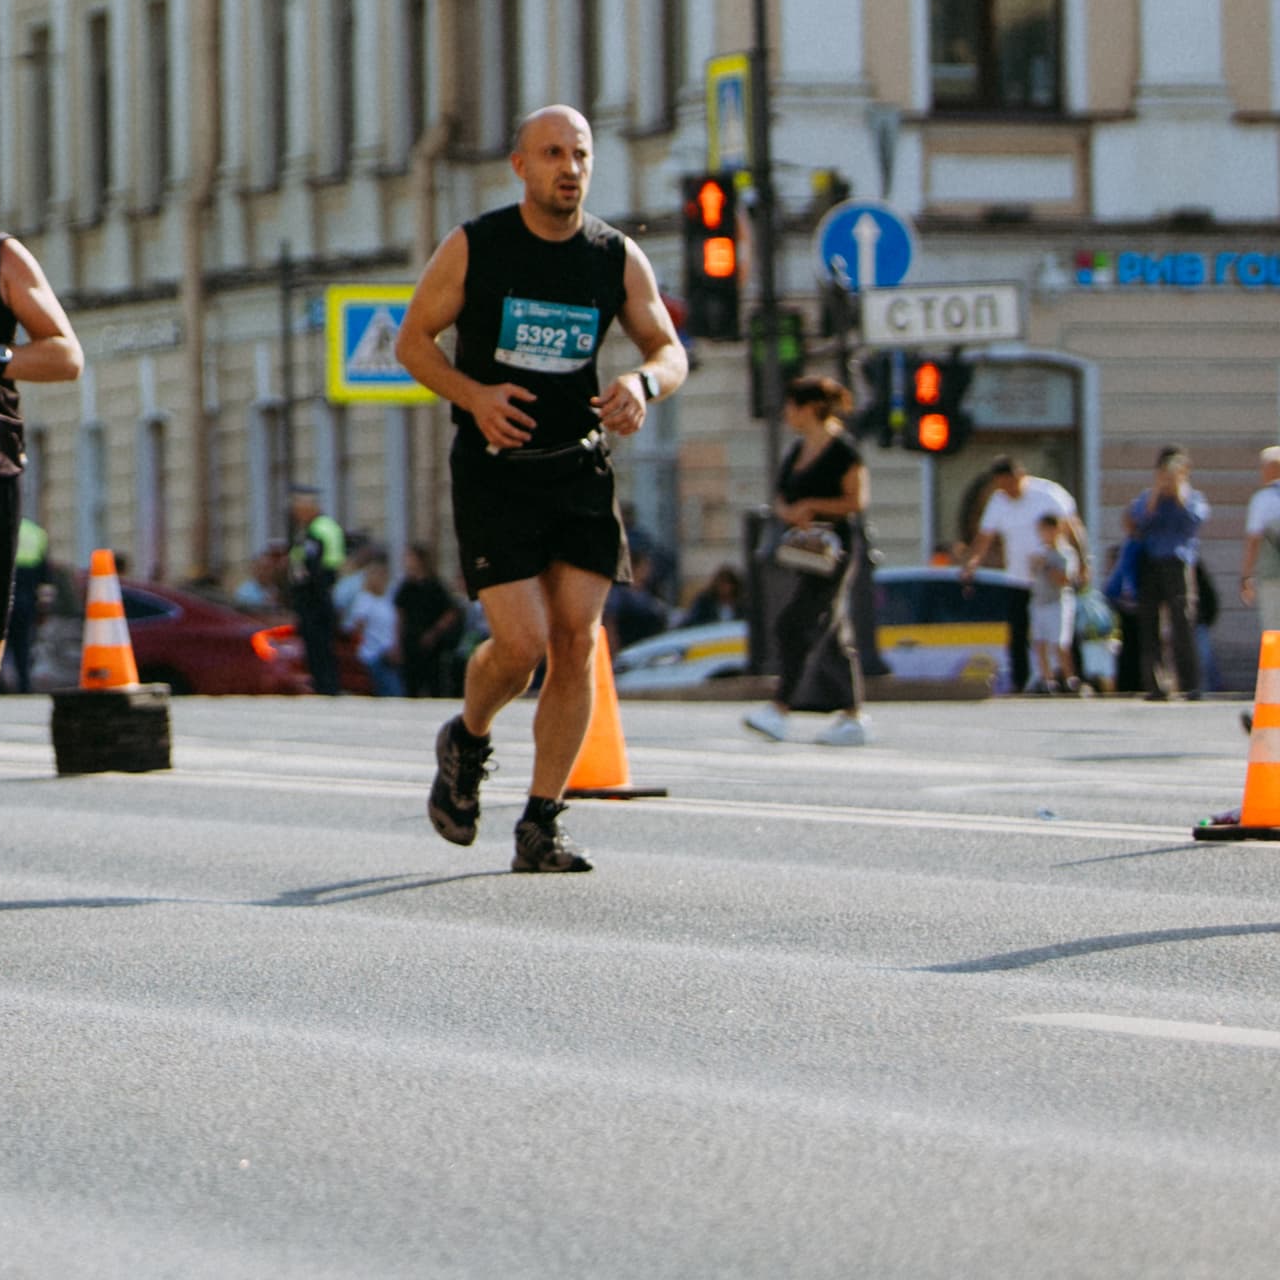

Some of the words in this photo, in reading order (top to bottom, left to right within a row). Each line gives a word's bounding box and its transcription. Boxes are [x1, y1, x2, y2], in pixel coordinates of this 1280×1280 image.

[1116, 251, 1206, 287] РИВ
[885, 293, 999, 332] СТОП
[515, 323, 568, 348] 5392
